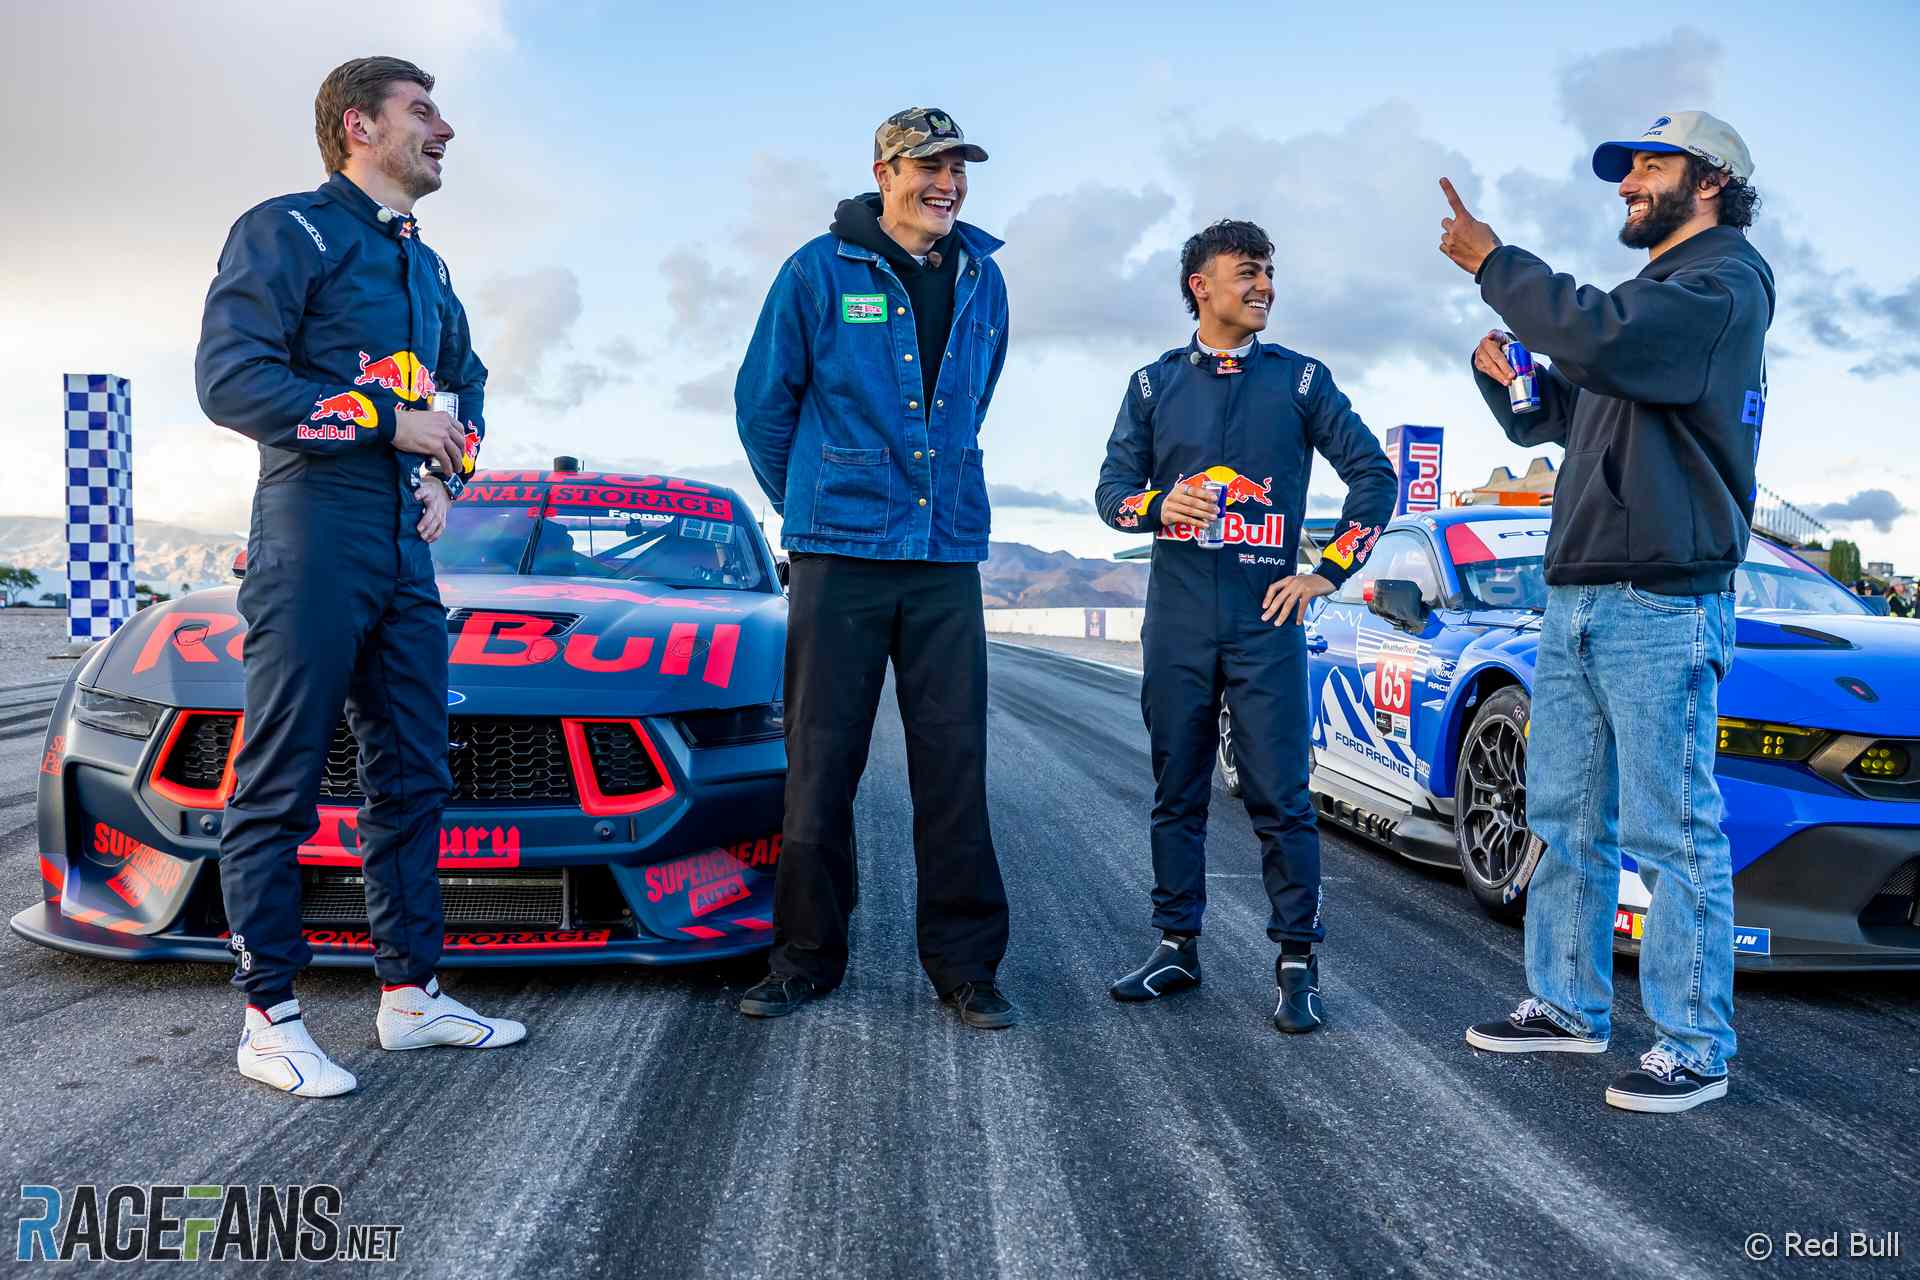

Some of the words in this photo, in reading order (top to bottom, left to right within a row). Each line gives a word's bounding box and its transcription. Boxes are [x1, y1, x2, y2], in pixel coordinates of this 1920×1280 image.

[287, 209, 326, 252] sparco
[1298, 362, 1317, 396] sparco
[297, 424, 326, 439] Red
[327, 424, 356, 440] Bull
[473, 469, 710, 494] MPOL
[1408, 442, 1441, 501] Bull
[461, 485, 546, 502] ONAL
[556, 486, 726, 517] STORAGE
[608, 509, 675, 523] Feeney
[1222, 512, 1285, 548] Bull
[449, 611, 742, 690] Bull
[1380, 660, 1406, 709] 65
[1427, 682, 1452, 694] RACI
[1335, 731, 1365, 754] FORD
[1366, 748, 1410, 779] RACING
[443, 928, 608, 945] TORAGE
